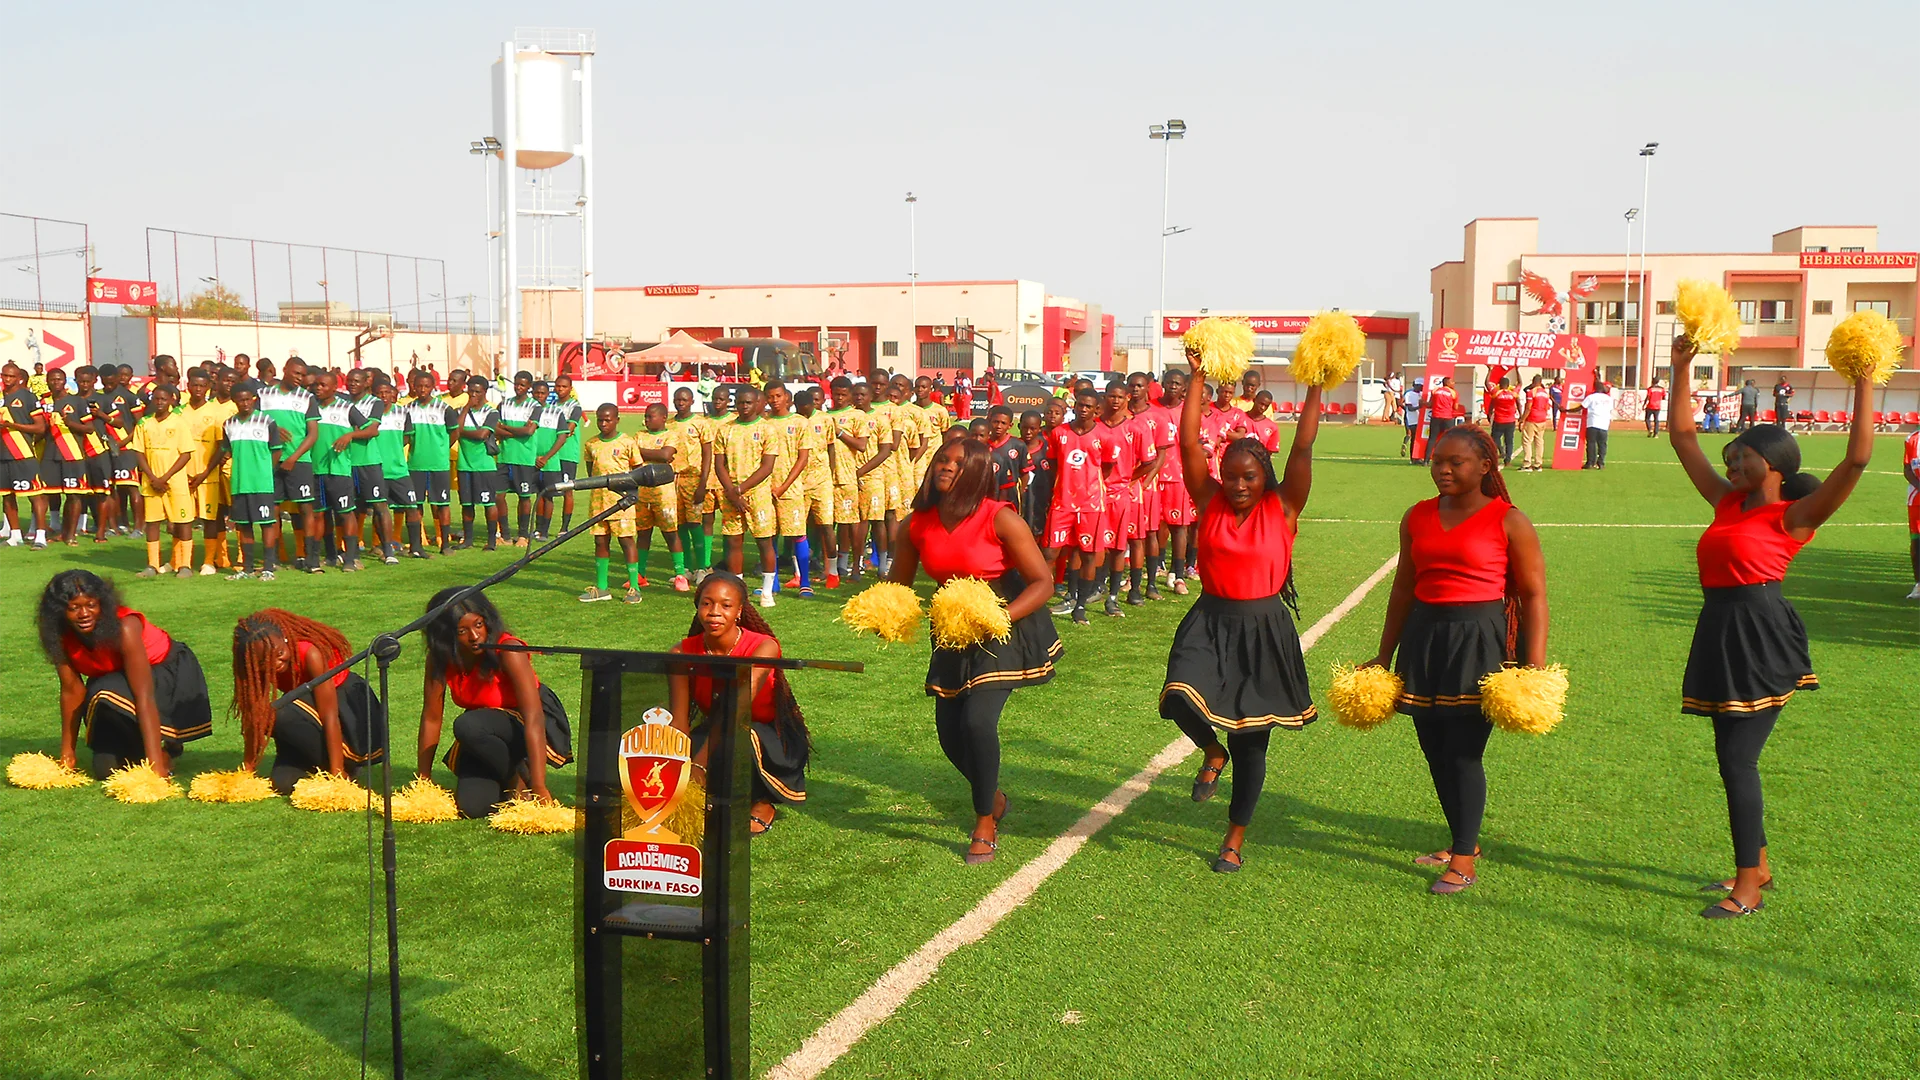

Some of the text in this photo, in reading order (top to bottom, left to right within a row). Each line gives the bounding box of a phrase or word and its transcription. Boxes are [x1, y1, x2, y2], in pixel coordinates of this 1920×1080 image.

[1803, 255, 1915, 265] HEBERGEMENT
[647, 286, 697, 294] VESTIAIRES
[1469, 331, 1556, 349] LÀ OÙ LES STARS
[1473, 346, 1503, 357] DEMAIN
[640, 390, 662, 398] FOCUS
[1007, 395, 1043, 406] Orange
[114, 469, 130, 479] 20
[13, 480, 30, 490] 29
[64, 478, 77, 487] 15
[520, 482, 529, 493] 13
[300, 484, 311, 497] 12
[373, 486, 380, 497] 6
[408, 491, 417, 501] 11
[441, 490, 447, 500] 4
[338, 495, 348, 508] 17
[205, 503, 211, 513] 2
[258, 505, 270, 518] 10
[1054, 531, 1067, 542] 10
[622, 723, 691, 757] TOURNOI
[647, 844, 659, 852] DES
[618, 851, 690, 873] ACADEMIES
[608, 877, 700, 895] BURKINA FASO
